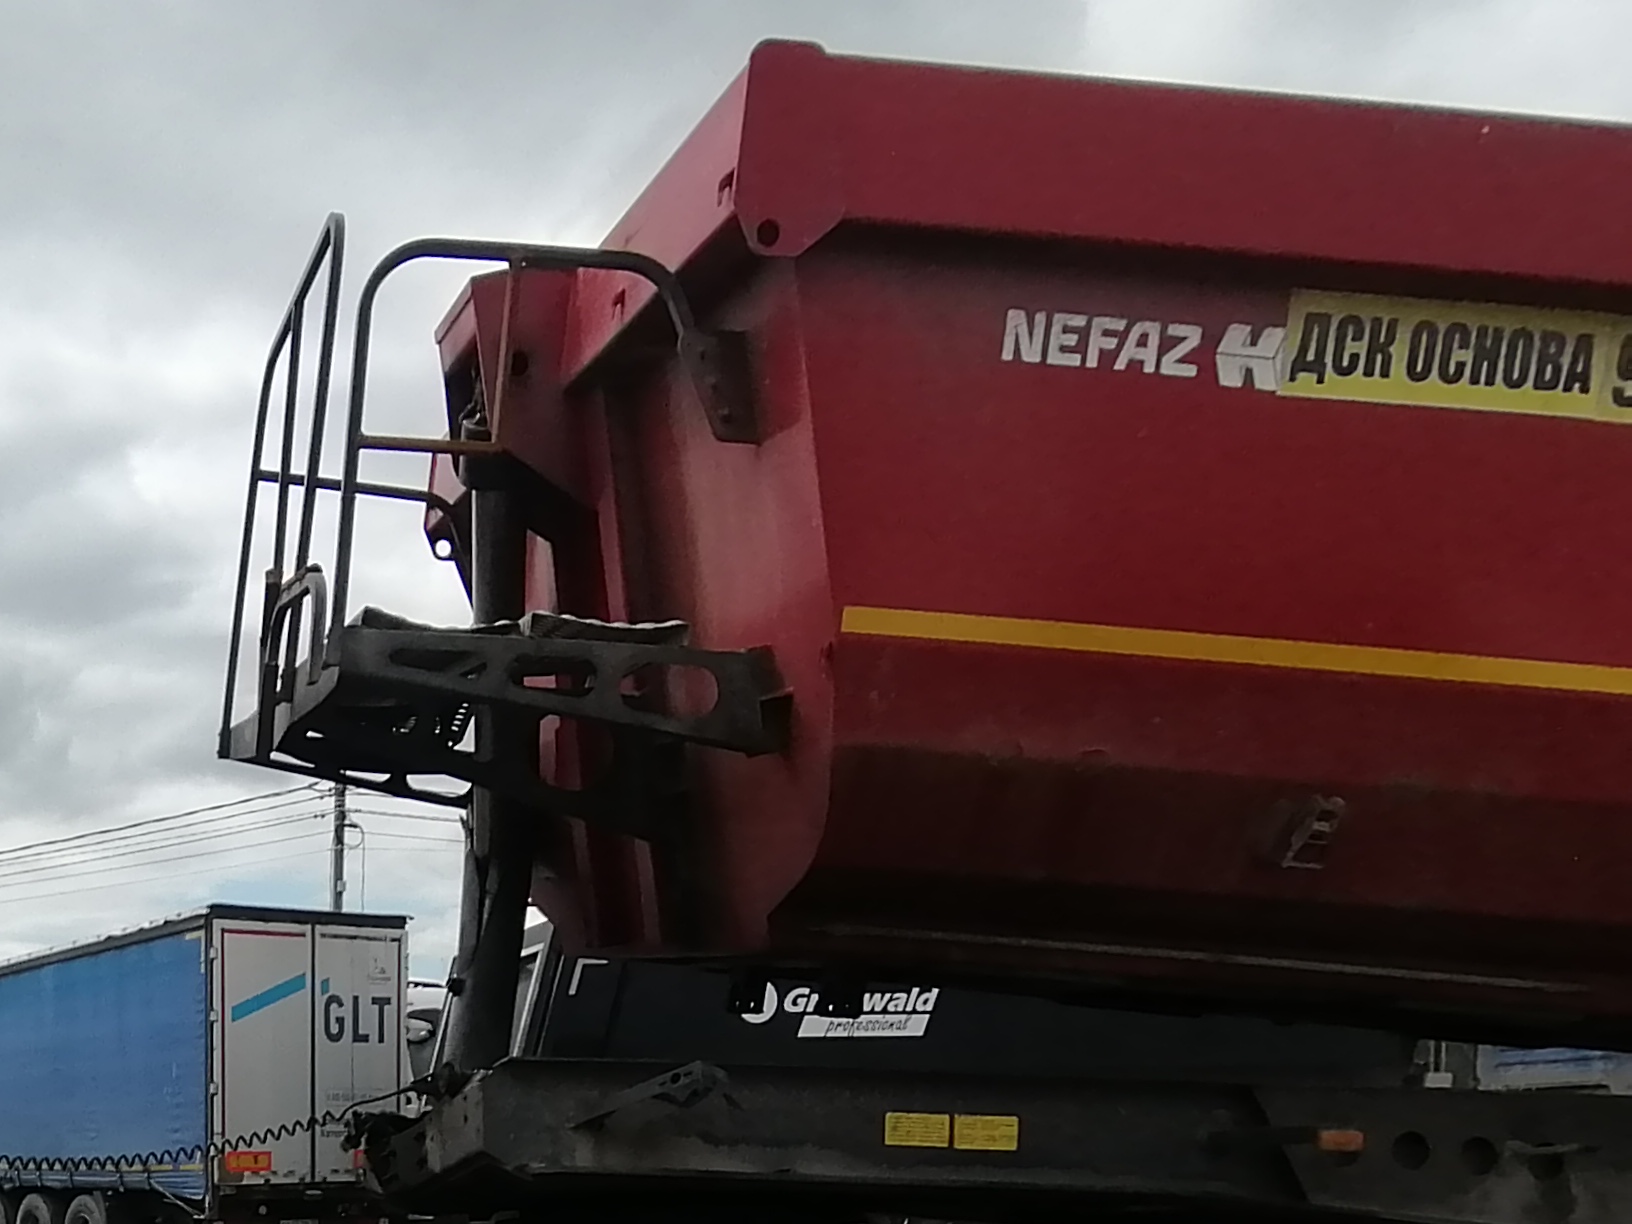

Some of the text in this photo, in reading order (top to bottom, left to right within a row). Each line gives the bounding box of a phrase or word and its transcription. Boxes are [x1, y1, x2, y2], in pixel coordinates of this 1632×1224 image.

[1001, 308, 1204, 378] NEFAZ
[1288, 312, 1399, 384] ДСК
[1406, 319, 1595, 395] ОСНОВА
[324, 995, 391, 1044] GLT
